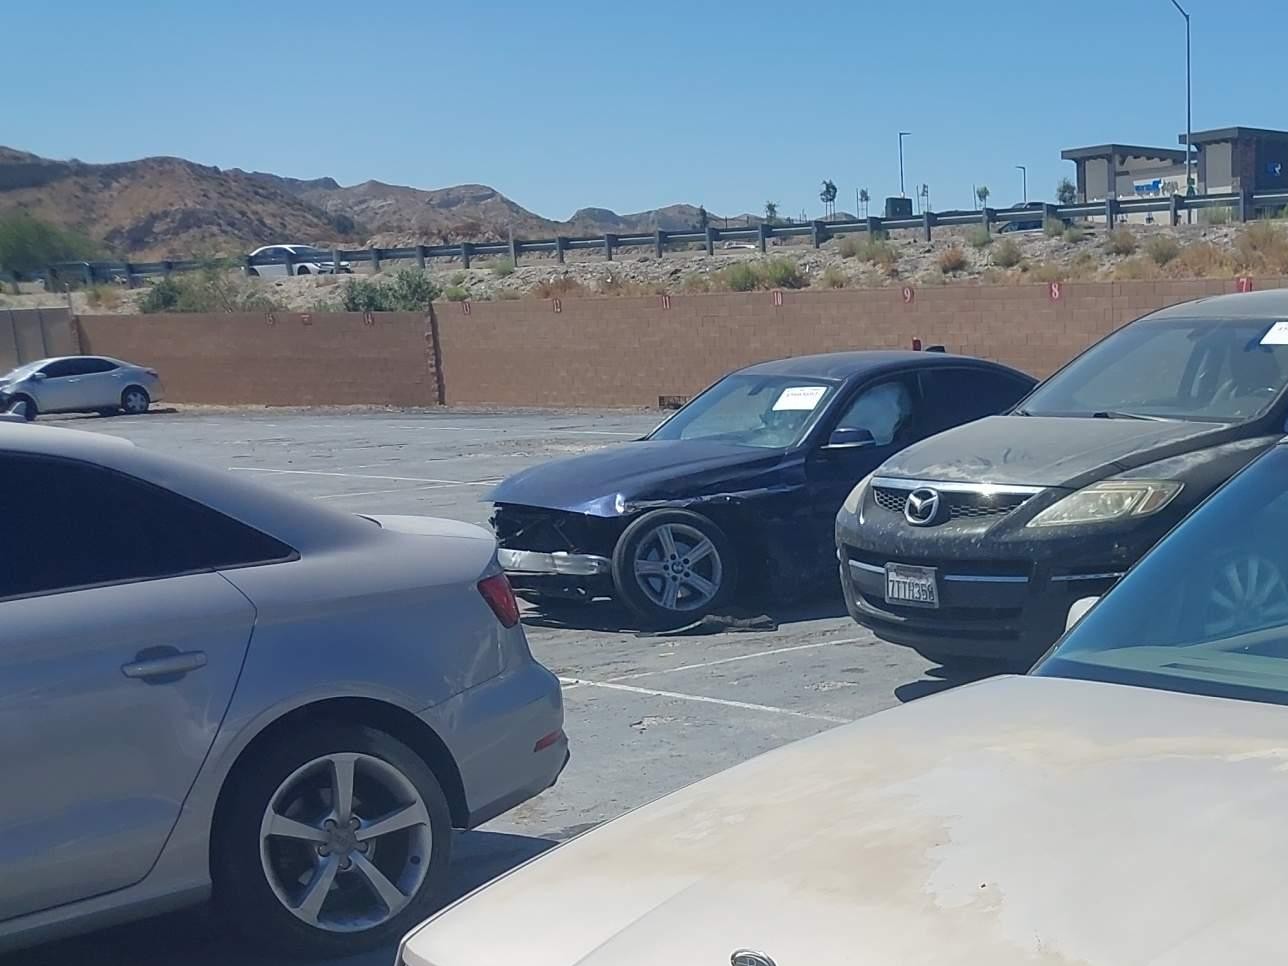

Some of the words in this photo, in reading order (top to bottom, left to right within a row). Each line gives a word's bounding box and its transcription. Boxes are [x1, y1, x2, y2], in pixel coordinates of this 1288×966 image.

[1051, 282, 1060, 299] 8
[1239, 278, 1247, 292] 7
[903, 287, 911, 303] 9
